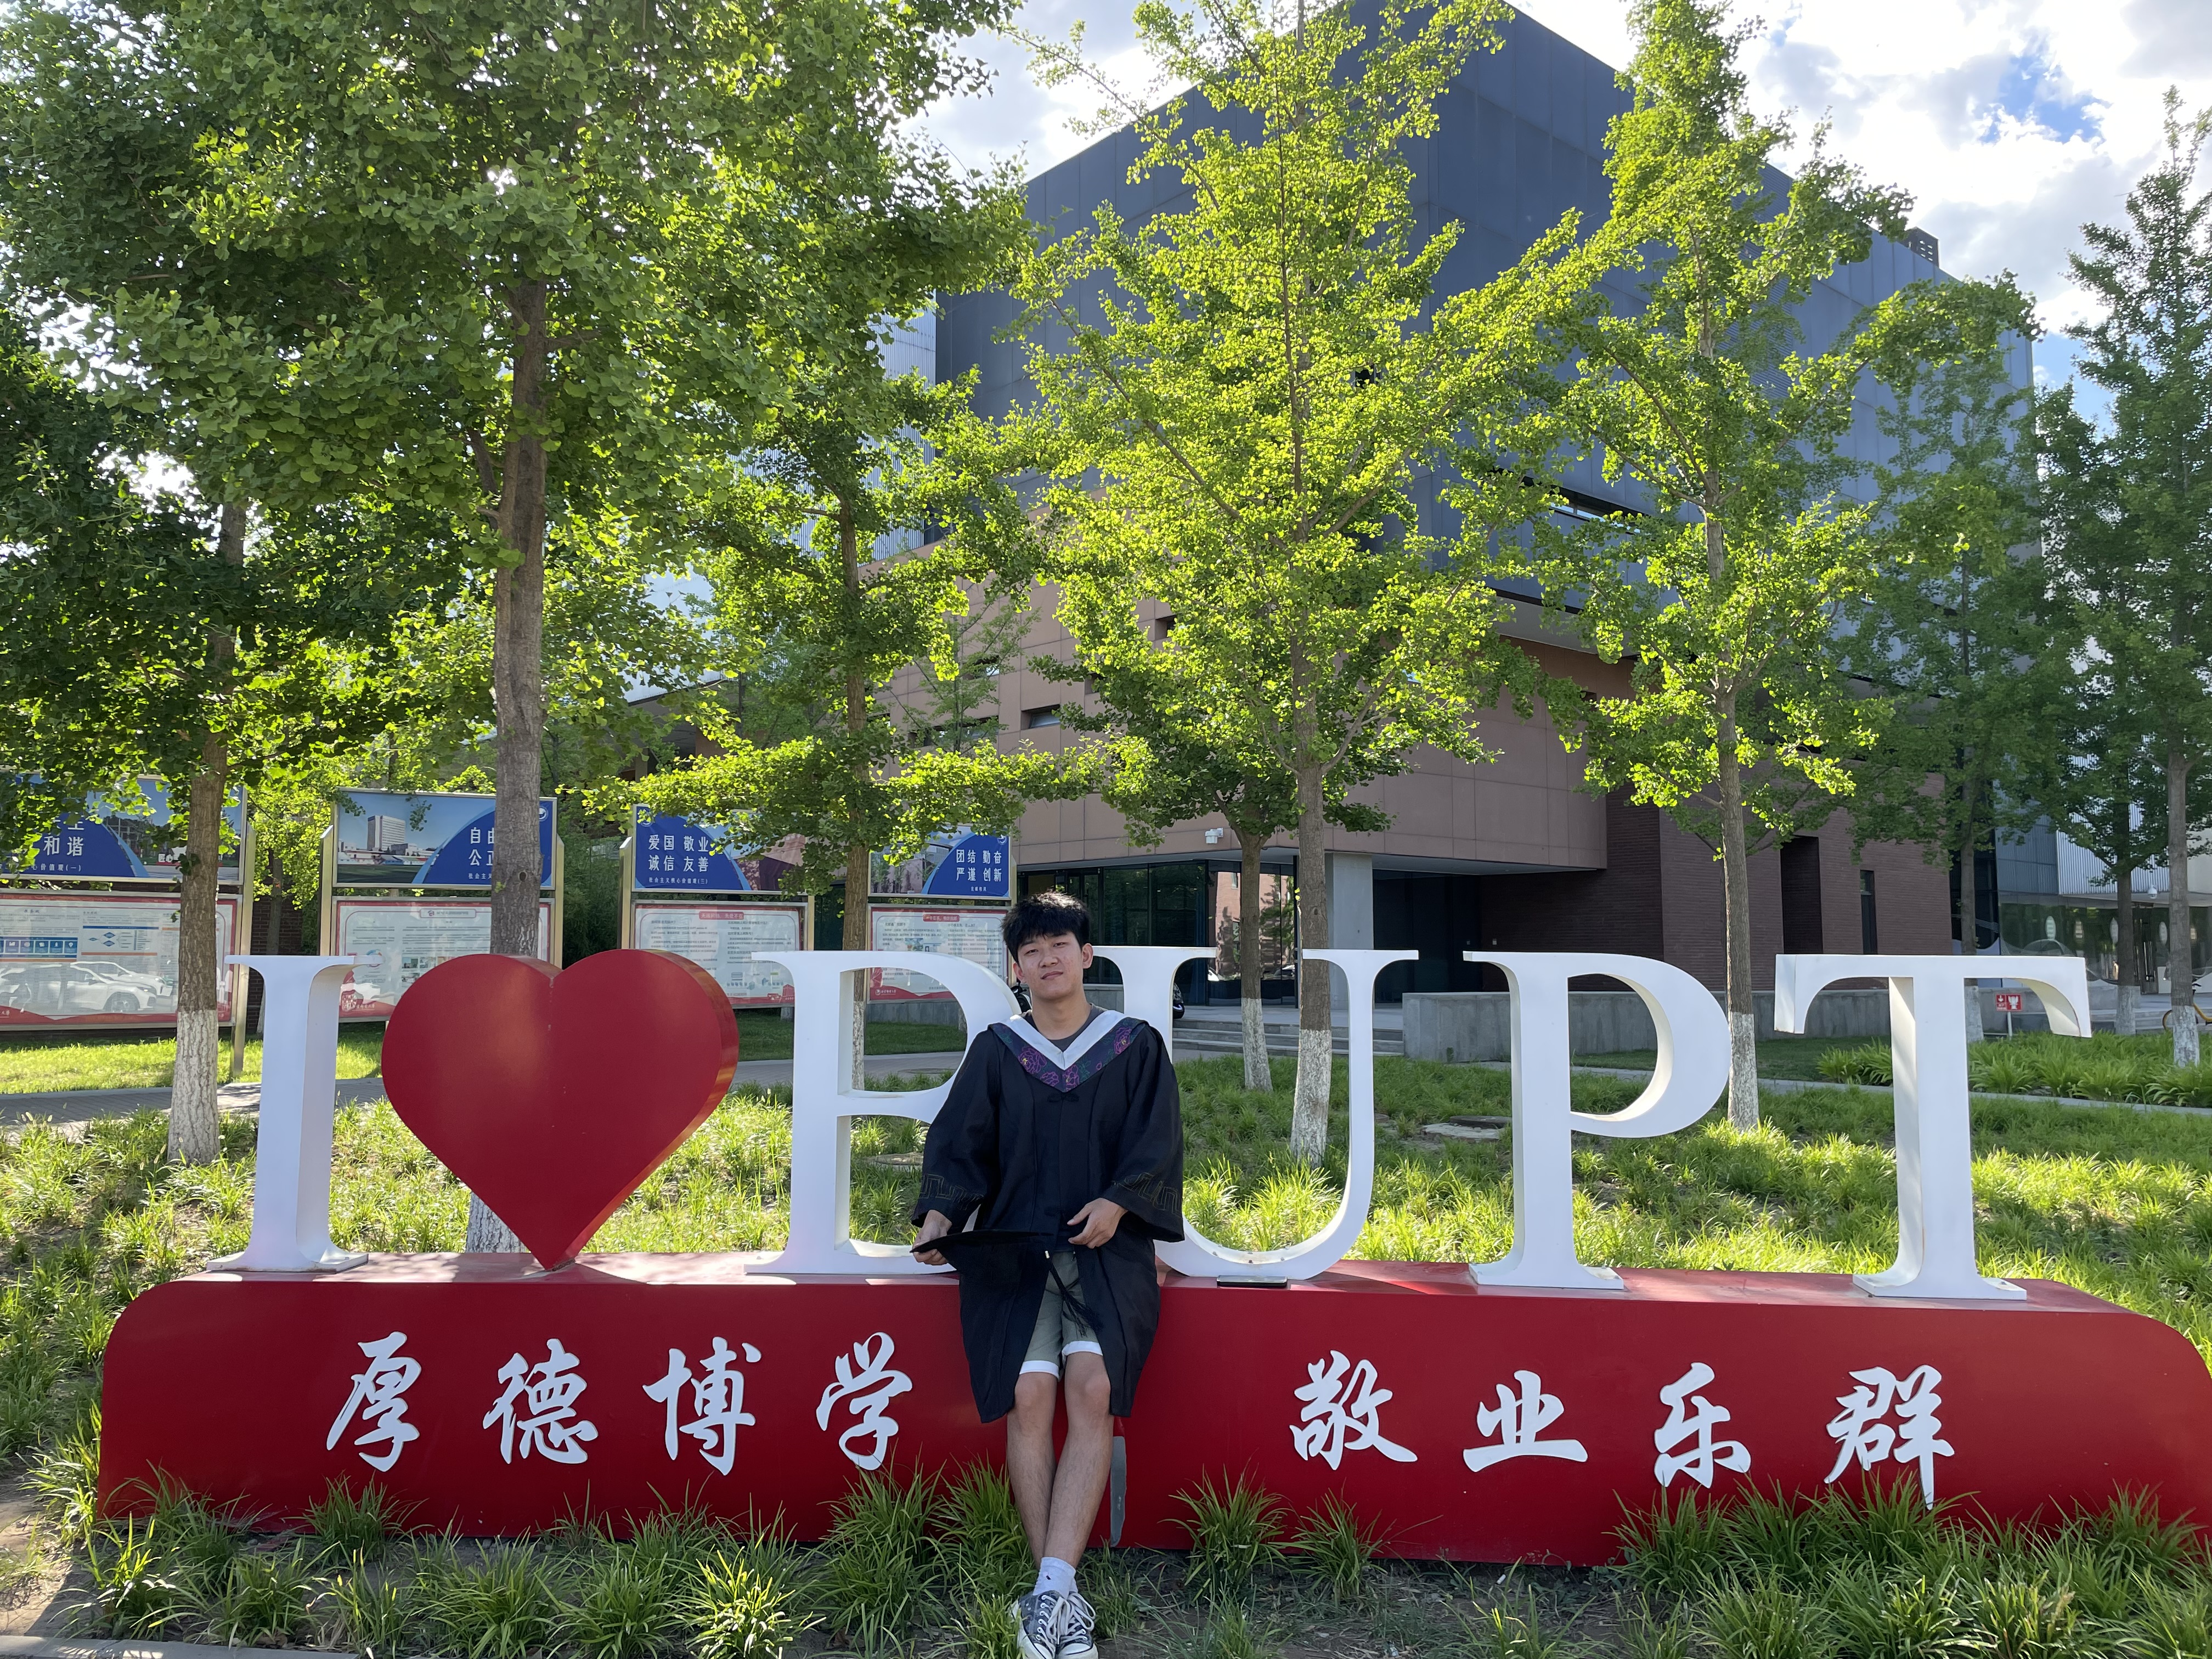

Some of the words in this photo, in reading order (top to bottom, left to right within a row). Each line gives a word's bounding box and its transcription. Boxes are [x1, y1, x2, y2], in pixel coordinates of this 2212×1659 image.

[43, 836, 84, 857] 和谐
[648, 834, 675, 850] 爱国
[684, 836, 709, 852] 敬业
[648, 854, 675, 871] 诚信
[684, 856, 709, 872] 友善
[956, 849, 976, 864] 团结
[983, 850, 1002, 864] 勤奋
[956, 867, 977, 881] 严谨
[983, 867, 1002, 882] 创新
[206, 955, 383, 1274] I
[326, 1331, 913, 1476] 厚德博学
[1289, 1349, 1955, 1510] 敬业乐群
